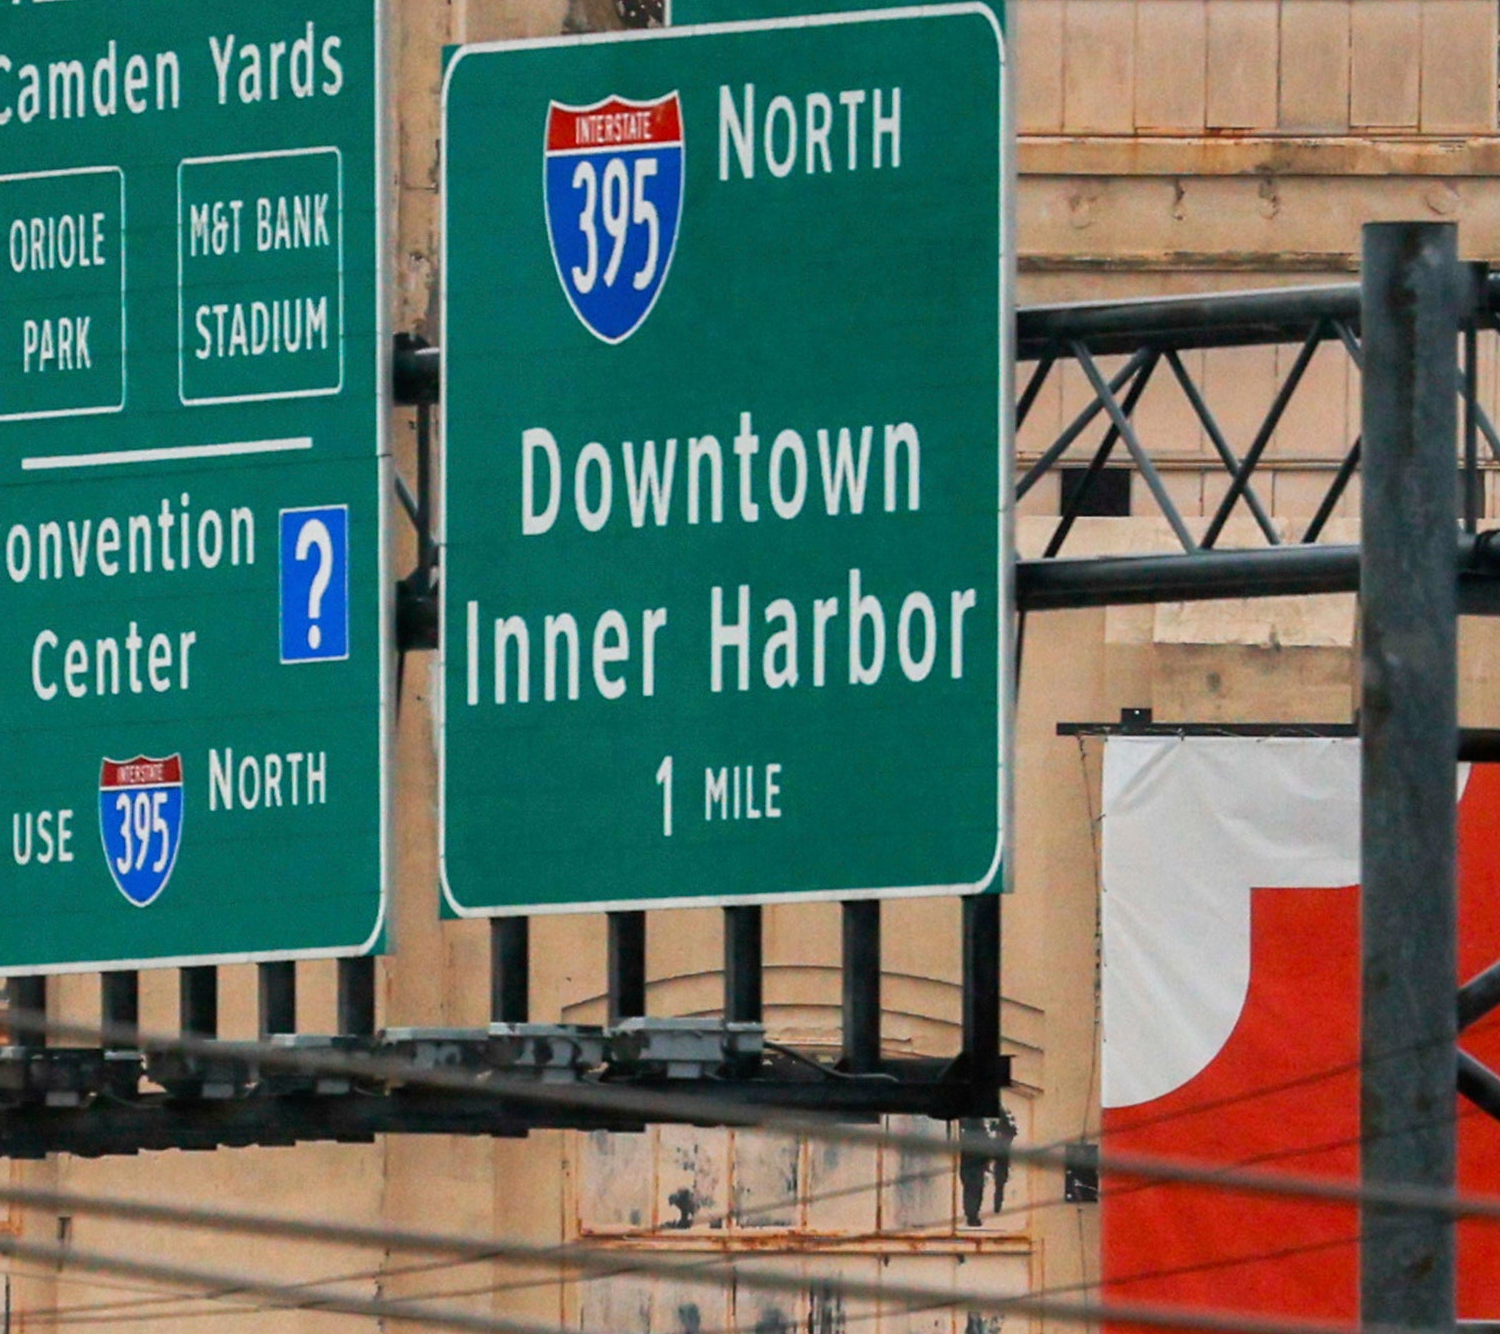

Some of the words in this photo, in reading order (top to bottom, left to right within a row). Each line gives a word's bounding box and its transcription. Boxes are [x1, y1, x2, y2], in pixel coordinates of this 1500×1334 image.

[209, 20, 344, 104] Yards
[575, 111, 653, 146] INTERSTATE
[719, 82, 901, 182] NORTH
[10, 212, 106, 273] ORIOLE
[191, 199, 244, 257] M&T
[257, 193, 329, 252] BANK
[571, 158, 660, 294] 395
[24, 316, 92, 373] PARK
[196, 296, 328, 359] STADIUM
[522, 411, 920, 536] Downtown
[32, 620, 197, 701] Center
[466, 600, 667, 706] Inner
[711, 568, 976, 693] Harbor
[209, 747, 327, 812] NORTH
[656, 755, 673, 836] 1
[705, 763, 782, 820] MILE
[13, 808, 74, 866] USE
[115, 791, 170, 875] 395
